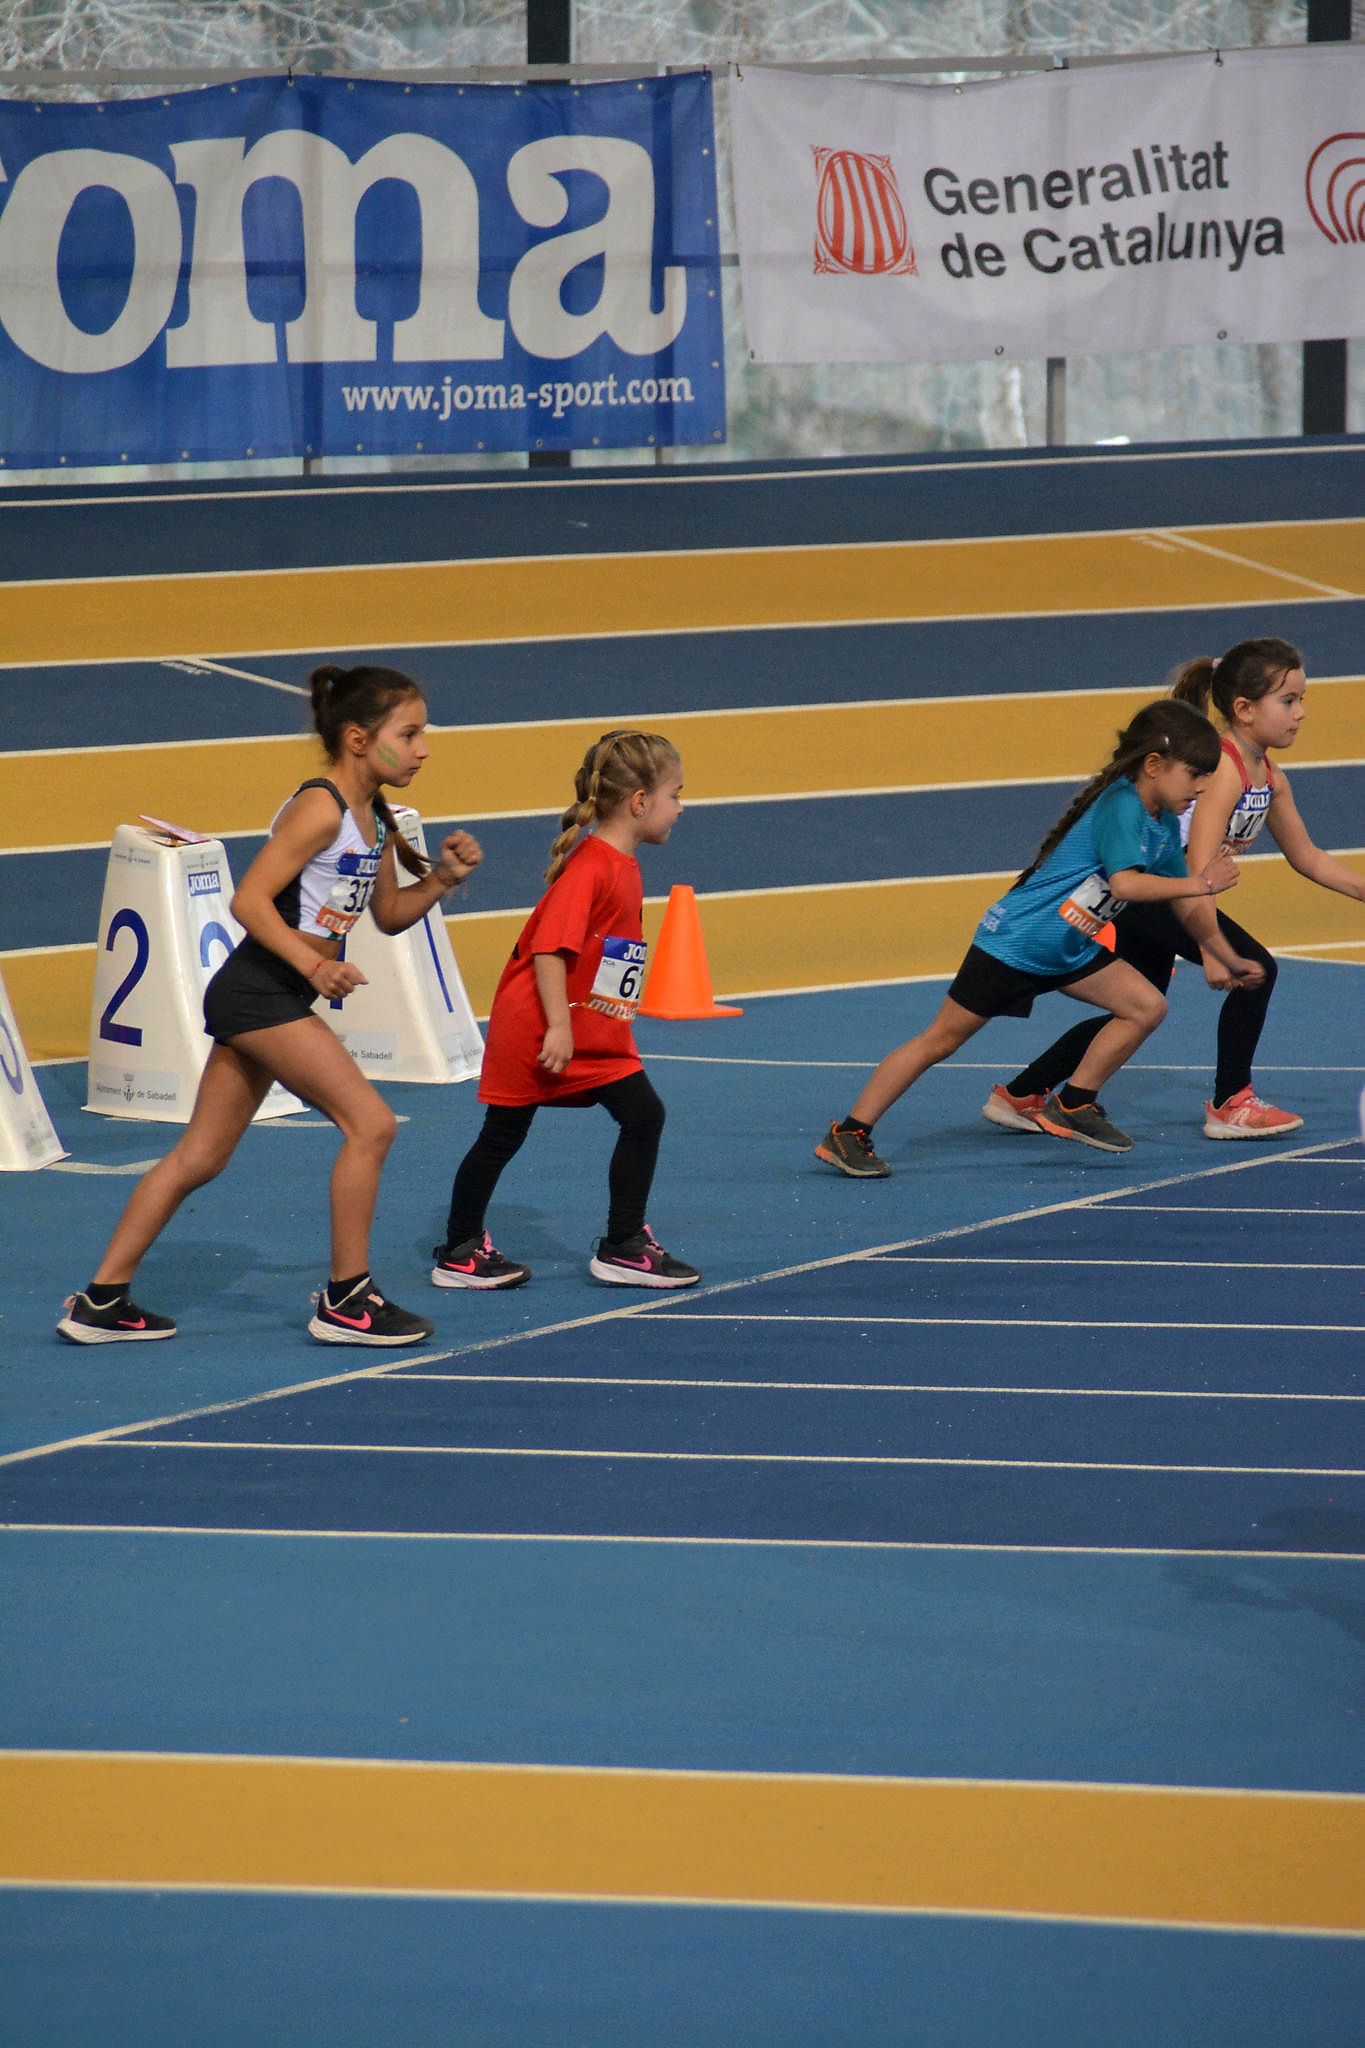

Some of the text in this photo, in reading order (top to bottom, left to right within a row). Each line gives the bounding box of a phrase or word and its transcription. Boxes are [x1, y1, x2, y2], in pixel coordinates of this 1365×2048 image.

[923, 141, 1230, 216] Generalitat
[0, 128, 688, 375] oma
[940, 212, 1285, 279] de Catalunya
[342, 373, 694, 420] www.joma-sport.com
[99, 908, 150, 1047] 2
